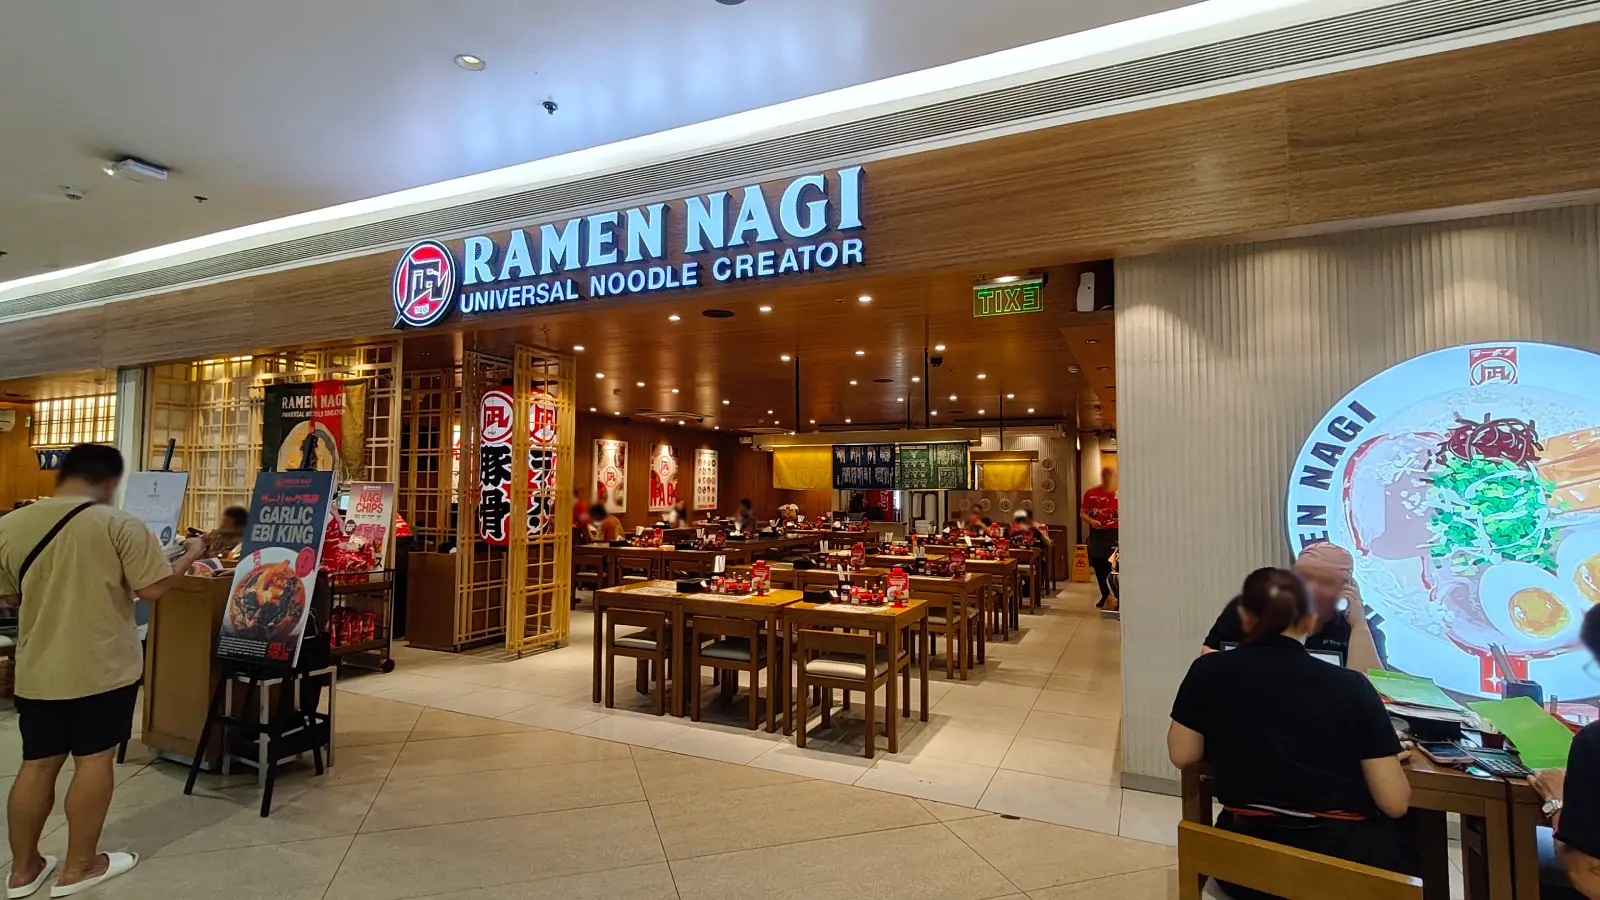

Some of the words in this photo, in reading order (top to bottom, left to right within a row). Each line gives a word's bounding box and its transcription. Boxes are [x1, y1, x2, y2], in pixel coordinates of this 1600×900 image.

[463, 203, 669, 285] RAMEN
[685, 166, 864, 254] NAGI
[460, 280, 578, 314] UNIVERSAL
[590, 262, 697, 295] NOODLE
[714, 239, 864, 282] CREATOR
[282, 395, 318, 409] RAMEN
[320, 392, 347, 407] NAGI
[1299, 400, 1377, 491] NAGI
[360, 491, 382, 502] NAGI
[260, 505, 313, 525] GARLIC
[355, 502, 383, 513] CHIPS
[251, 524, 275, 542] EBI
[276, 525, 314, 544] KING
